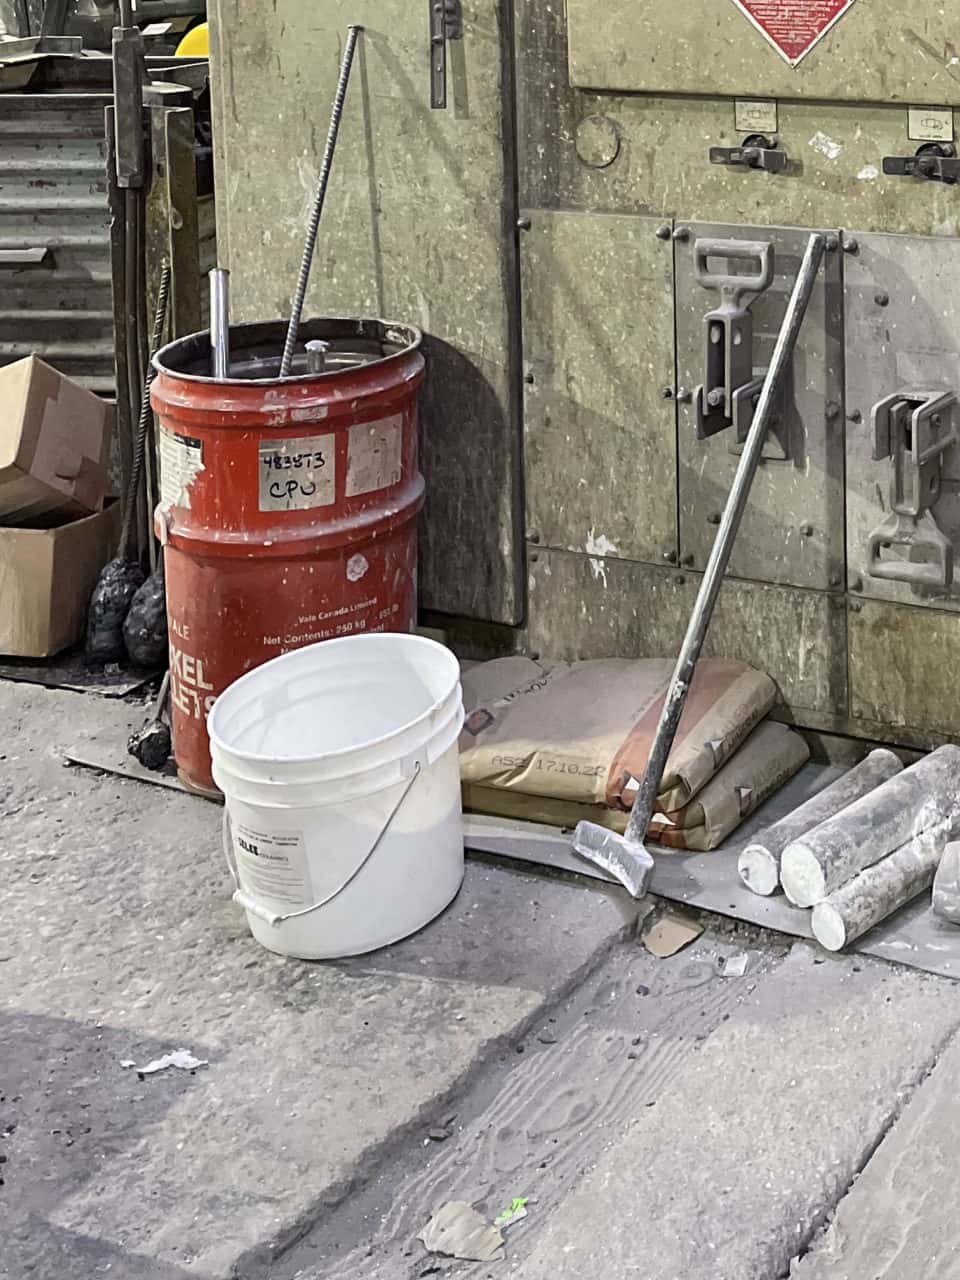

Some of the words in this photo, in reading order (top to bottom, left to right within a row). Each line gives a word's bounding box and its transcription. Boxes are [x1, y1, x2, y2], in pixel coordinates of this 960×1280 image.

[270, 480, 316, 499] CPU
[169, 617, 190, 640] ALE
[263, 636, 281, 646] Net
[335, 622, 353, 635] 250
[170, 644, 214, 691] KEL
[171, 674, 219, 720] LETS
